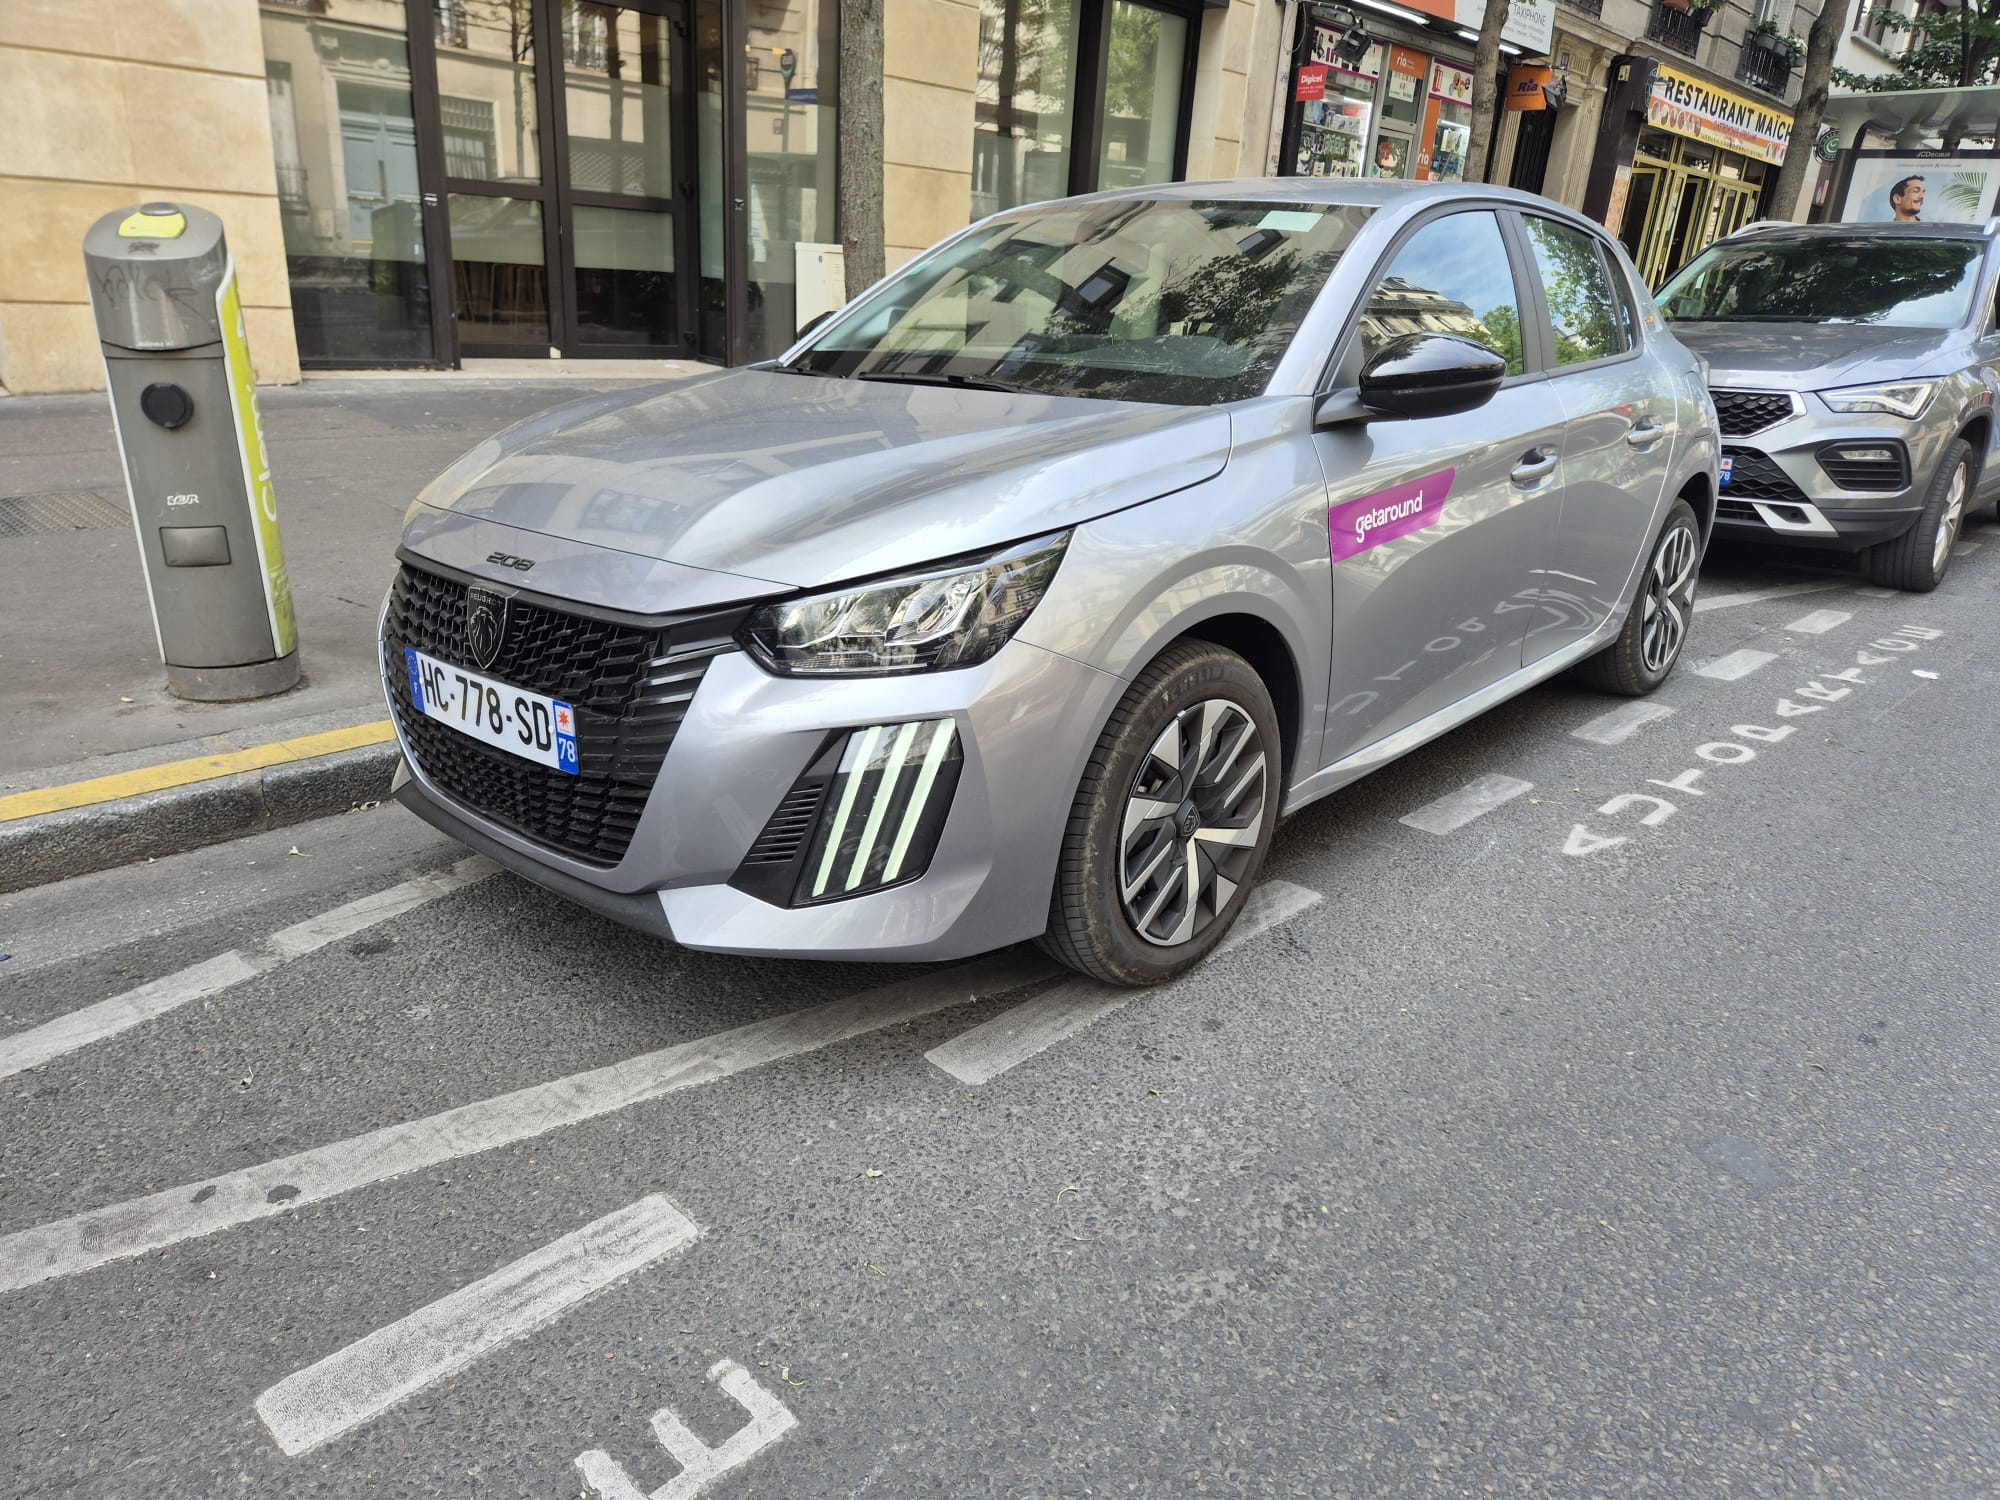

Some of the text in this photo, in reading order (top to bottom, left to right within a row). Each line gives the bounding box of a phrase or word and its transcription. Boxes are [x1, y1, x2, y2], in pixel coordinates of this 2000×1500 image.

[1513, 4, 1546, 27] TAXIPHONE
[1517, 78, 1538, 92] Ria
[1664, 76, 1755, 128] RESTAURANT
[1355, 489, 1423, 544] getaround
[486, 551, 536, 572] 208
[421, 658, 551, 752] HC-778-SD
[558, 736, 576, 763] 78
[1562, 623, 1945, 857] AUTOPARTAGE
